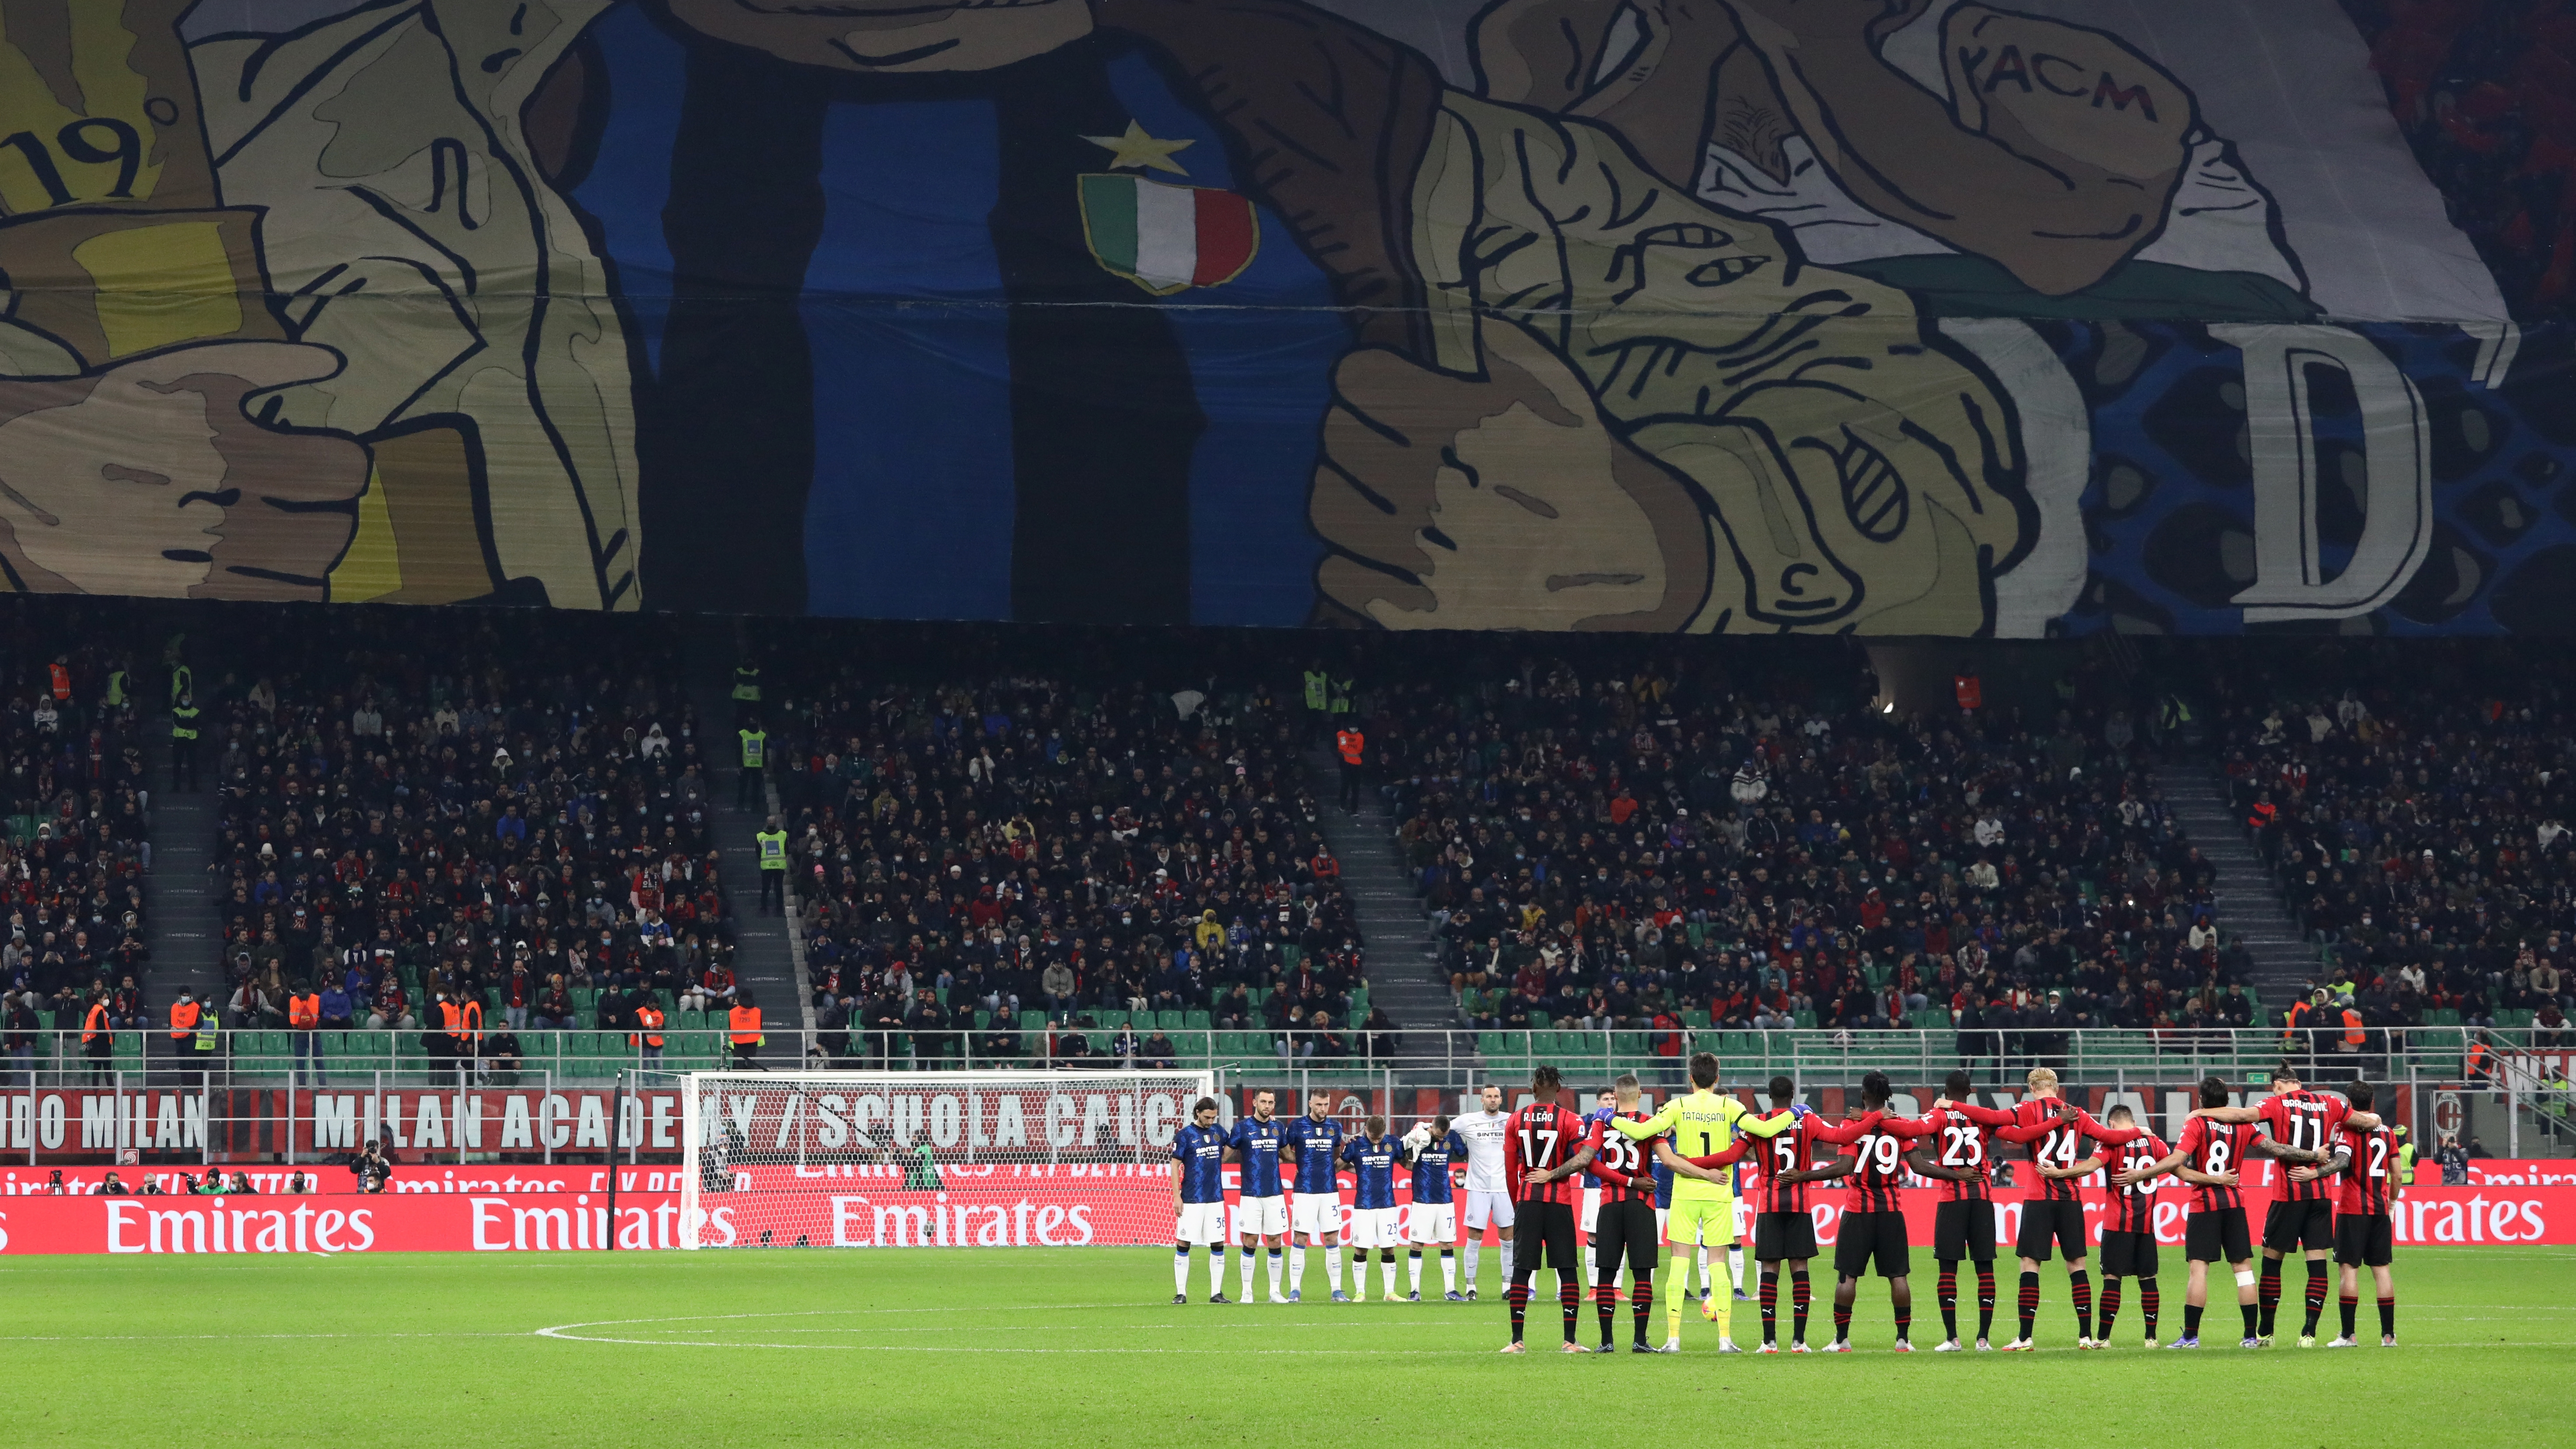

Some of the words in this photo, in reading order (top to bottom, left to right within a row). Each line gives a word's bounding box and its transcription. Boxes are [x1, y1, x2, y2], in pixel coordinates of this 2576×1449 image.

[315, 1095, 482, 1149] MILAN
[1524, 1111, 1553, 1122] R.LEÃO
[2291, 1115, 2321, 1151] 11
[1518, 1129, 1558, 1168] 17
[1603, 1130, 1640, 1170] 33
[1700, 1132, 1710, 1156] 1
[1775, 1137, 1795, 1175] 5
[1854, 1134, 1899, 1175] 79
[1943, 1126, 1982, 1166] 23
[2037, 1129, 2076, 1169] 24
[2206, 1140, 2229, 1177] 8
[2368, 1137, 2387, 1177] 2
[2123, 1155, 2157, 1196] 10
[105, 1197, 374, 1253] Emirates
[831, 1192, 1093, 1247] Emirates
[1216, 1217, 1225, 1228] 36
[1281, 1208, 1286, 1219] 6
[1387, 1223, 1397, 1235] 23
[2395, 1188, 2545, 1242] irates
